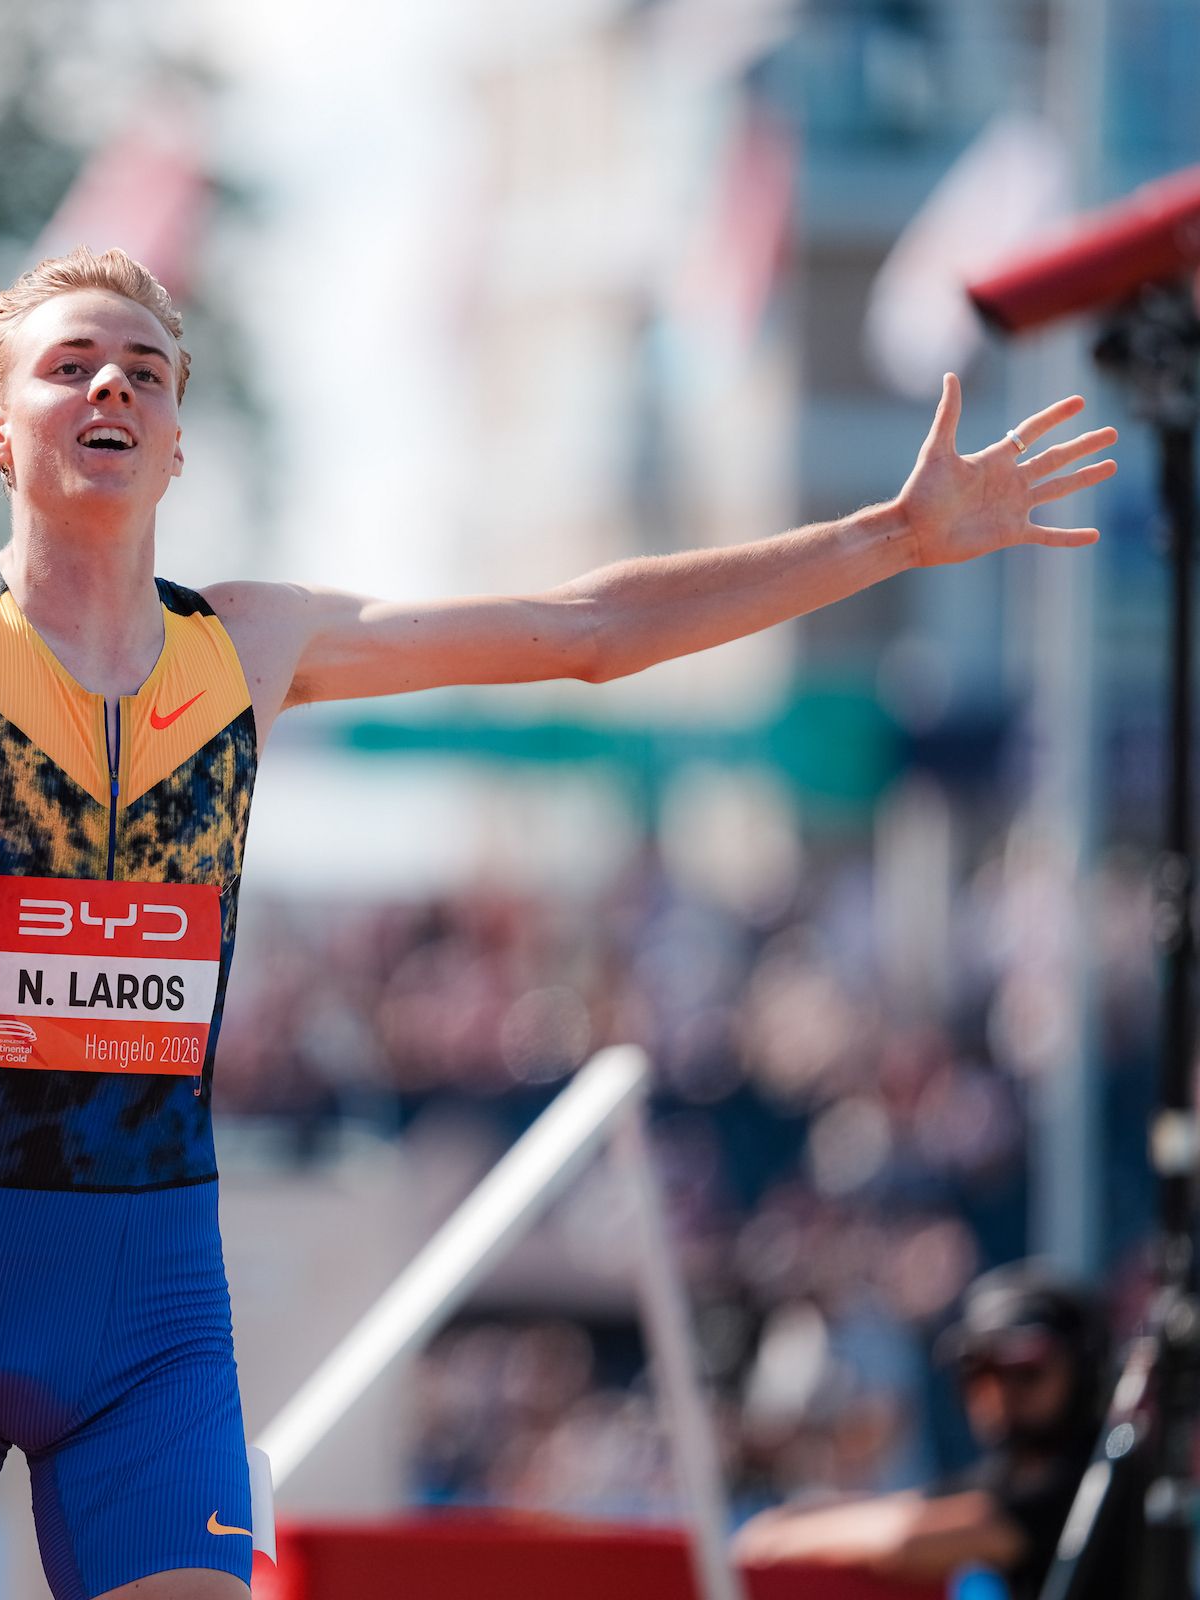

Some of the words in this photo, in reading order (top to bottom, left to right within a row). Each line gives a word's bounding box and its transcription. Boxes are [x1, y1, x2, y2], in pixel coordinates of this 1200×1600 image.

[18, 898, 188, 942] BYD
[17, 969, 55, 1006] N.
[68, 971, 185, 1011] LAROS
[5, 1053, 28, 1063] Gold
[85, 1033, 155, 1068] Hengelo
[159, 1036, 200, 1064] 2026
